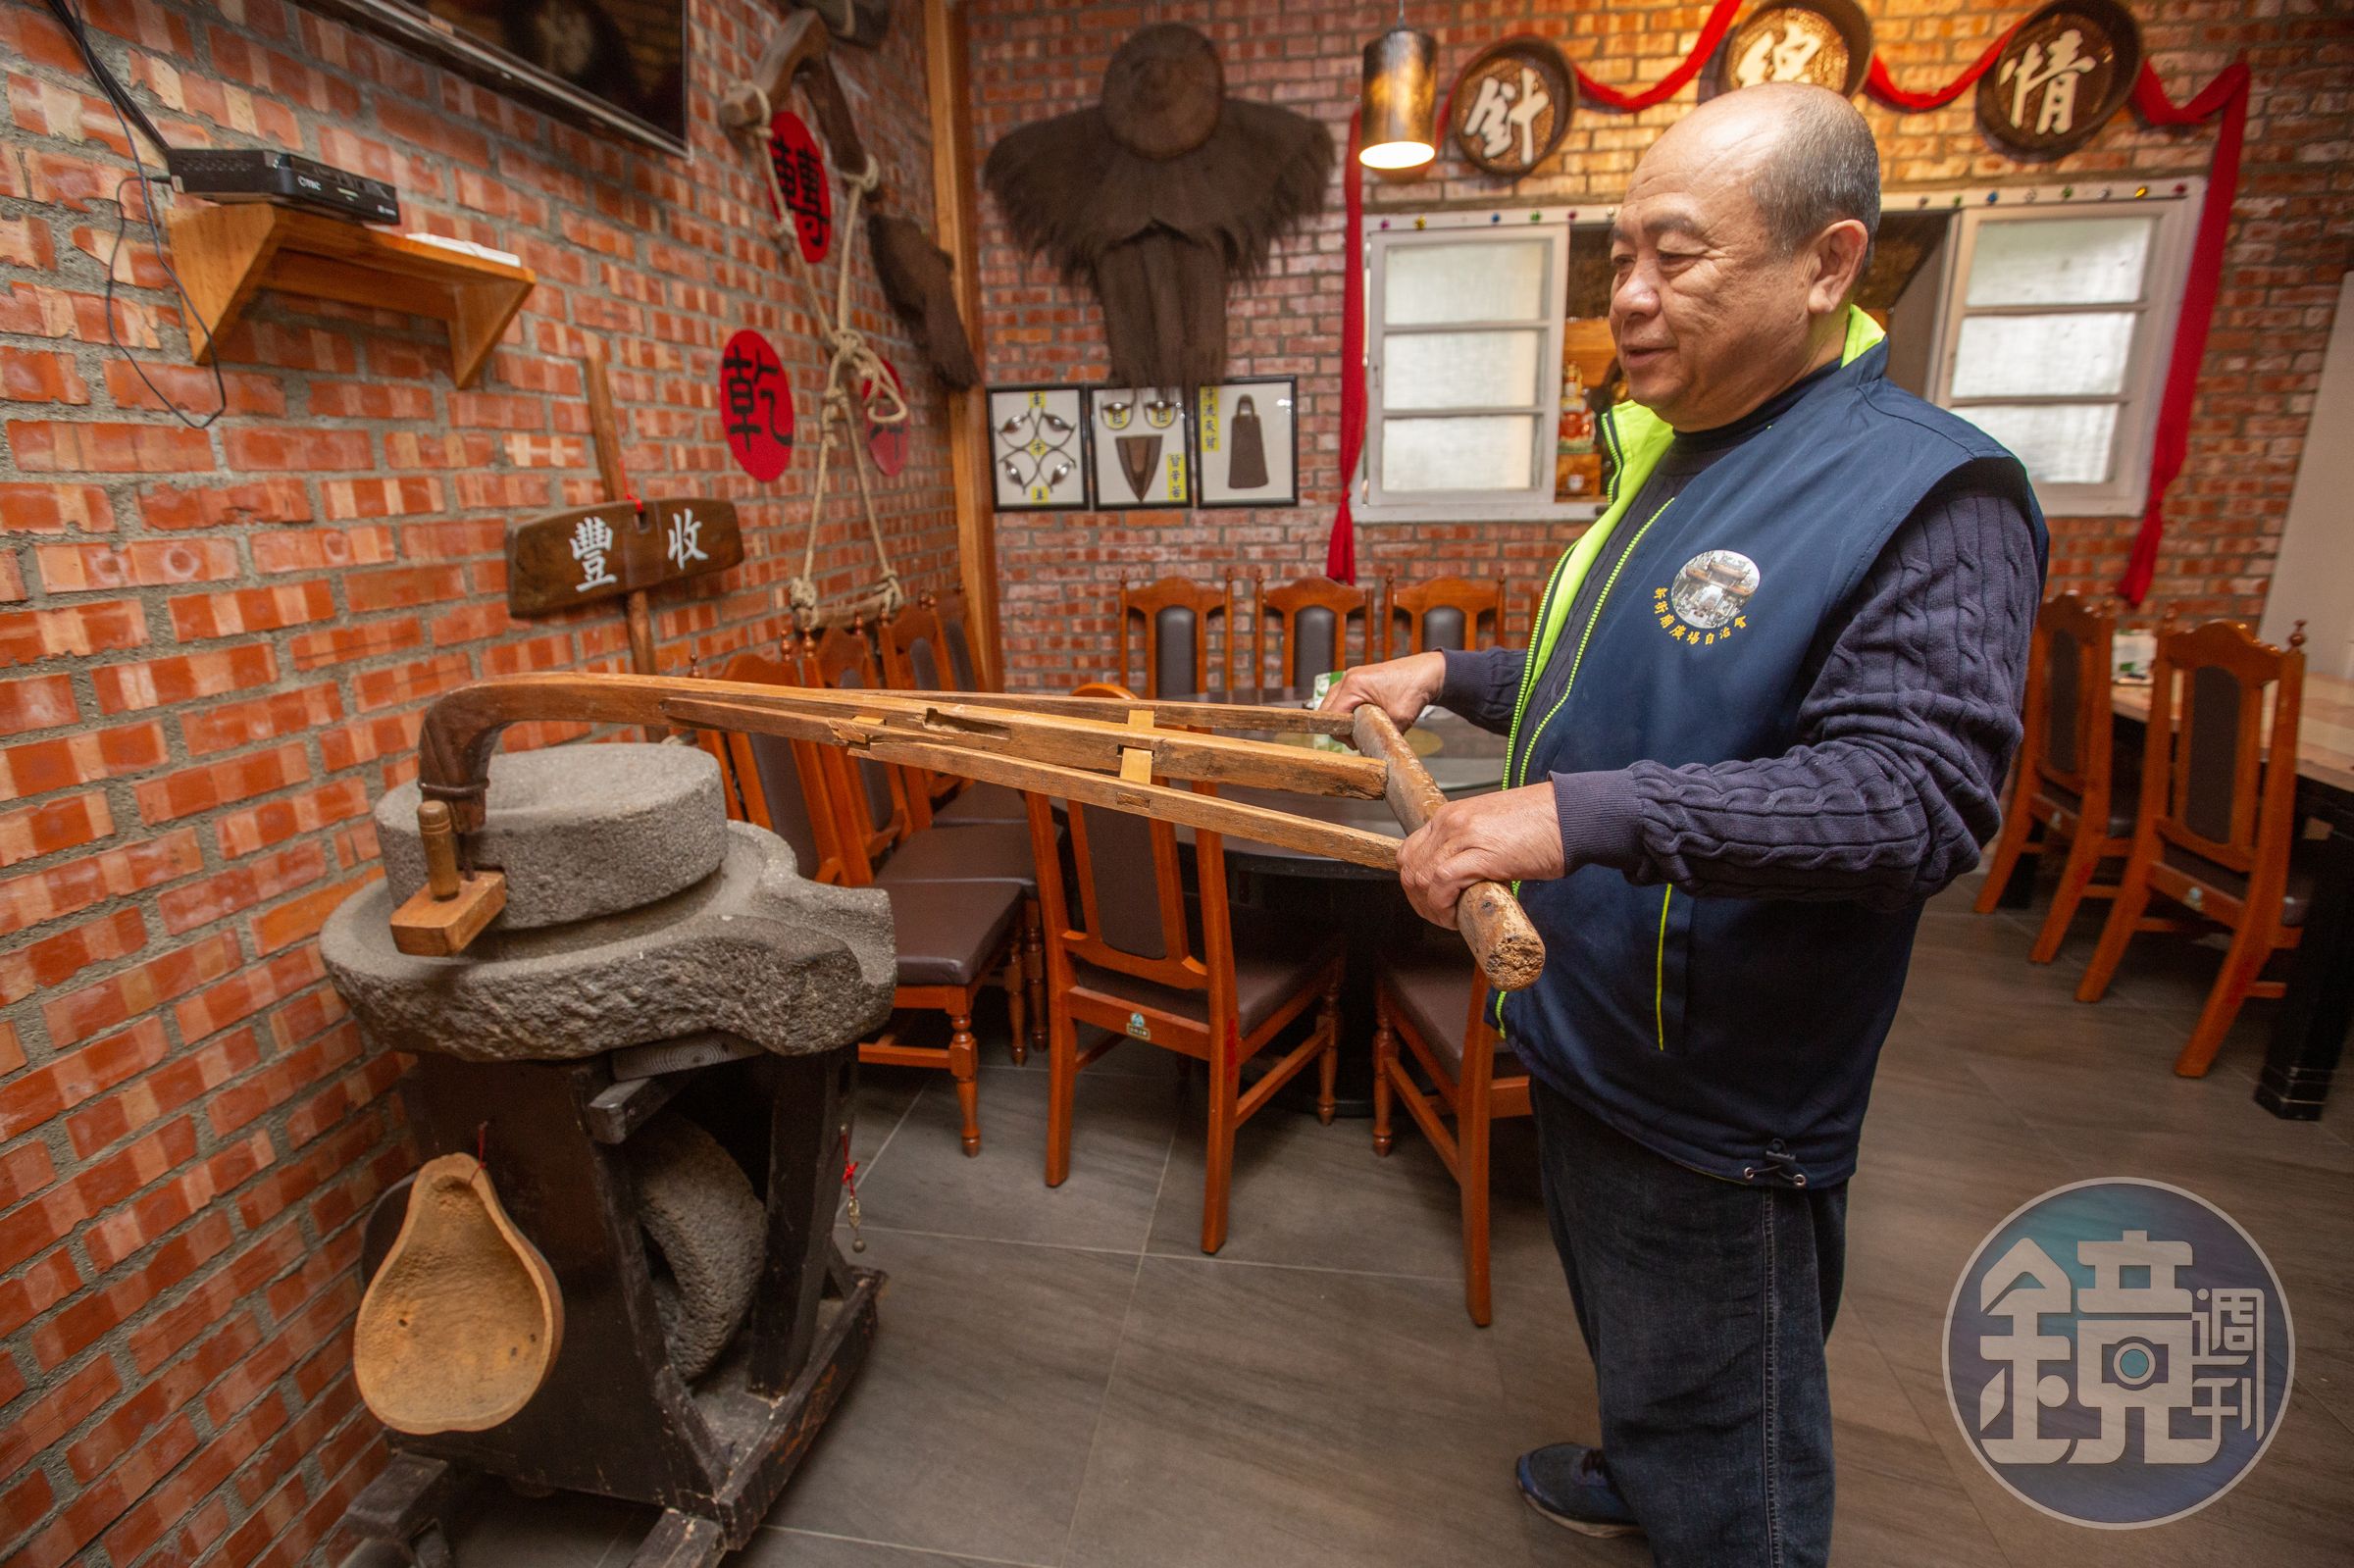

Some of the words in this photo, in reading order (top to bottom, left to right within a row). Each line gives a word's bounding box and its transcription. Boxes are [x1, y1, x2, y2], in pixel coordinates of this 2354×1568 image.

[1463, 67, 1550, 165] 針
[1999, 28, 2097, 135] 情
[723, 346, 793, 452] 乾
[569, 508, 709, 593] 豐收
